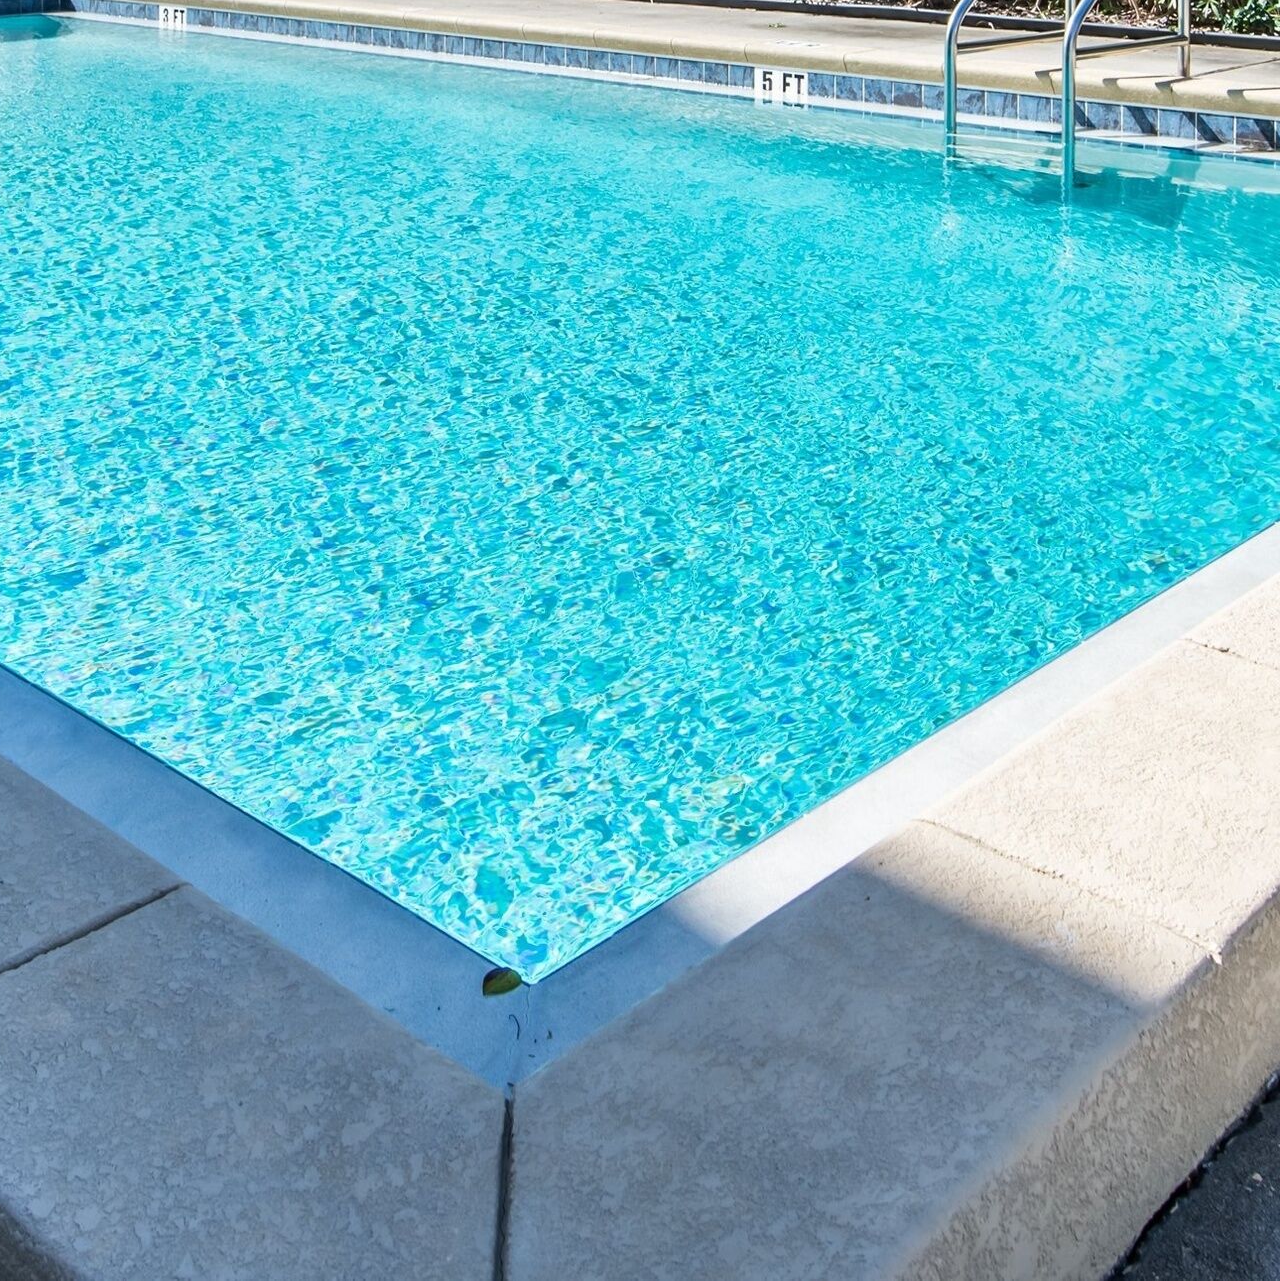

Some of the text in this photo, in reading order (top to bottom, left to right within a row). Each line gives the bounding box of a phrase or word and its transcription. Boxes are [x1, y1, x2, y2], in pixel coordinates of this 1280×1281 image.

[163, 8, 185, 24] 3 FT
[762, 71, 805, 95] 5 FT
